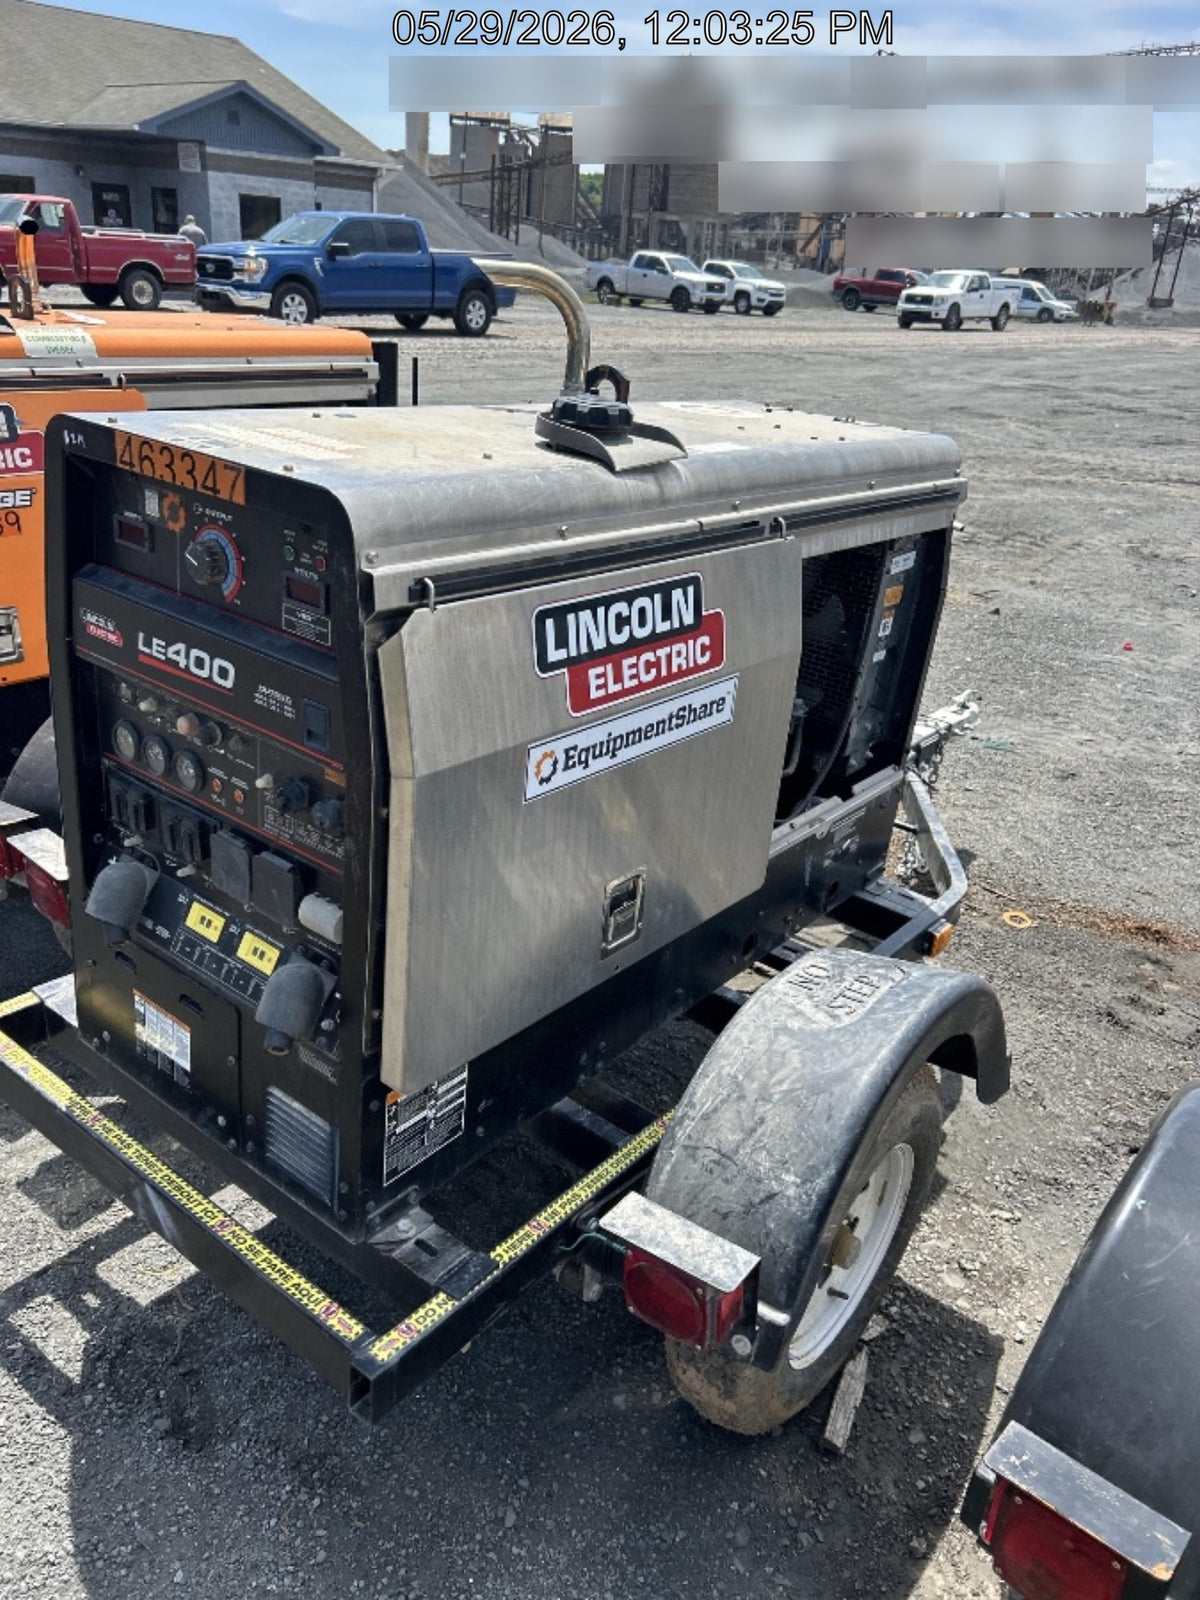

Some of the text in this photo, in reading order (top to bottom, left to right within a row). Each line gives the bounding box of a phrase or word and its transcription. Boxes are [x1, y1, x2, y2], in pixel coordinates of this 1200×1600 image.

[0, 447, 33, 470] IC
[118, 434, 243, 501] 463347
[545, 584, 695, 664] LINCOLN
[137, 631, 236, 690] LE400
[587, 635, 712, 700] ELECTRIC
[561, 695, 727, 772] EquipmentShare
[788, 964, 831, 991] NO
[827, 974, 880, 1016] STEP
[111, 1130, 134, 1150] PAS
[160, 1173, 204, 1209] DEBOUT
[227, 1230, 247, 1246] NO
[244, 1244, 263, 1260] SE
[260, 1257, 294, 1284] PARE
[415, 1307, 437, 1325] DO
